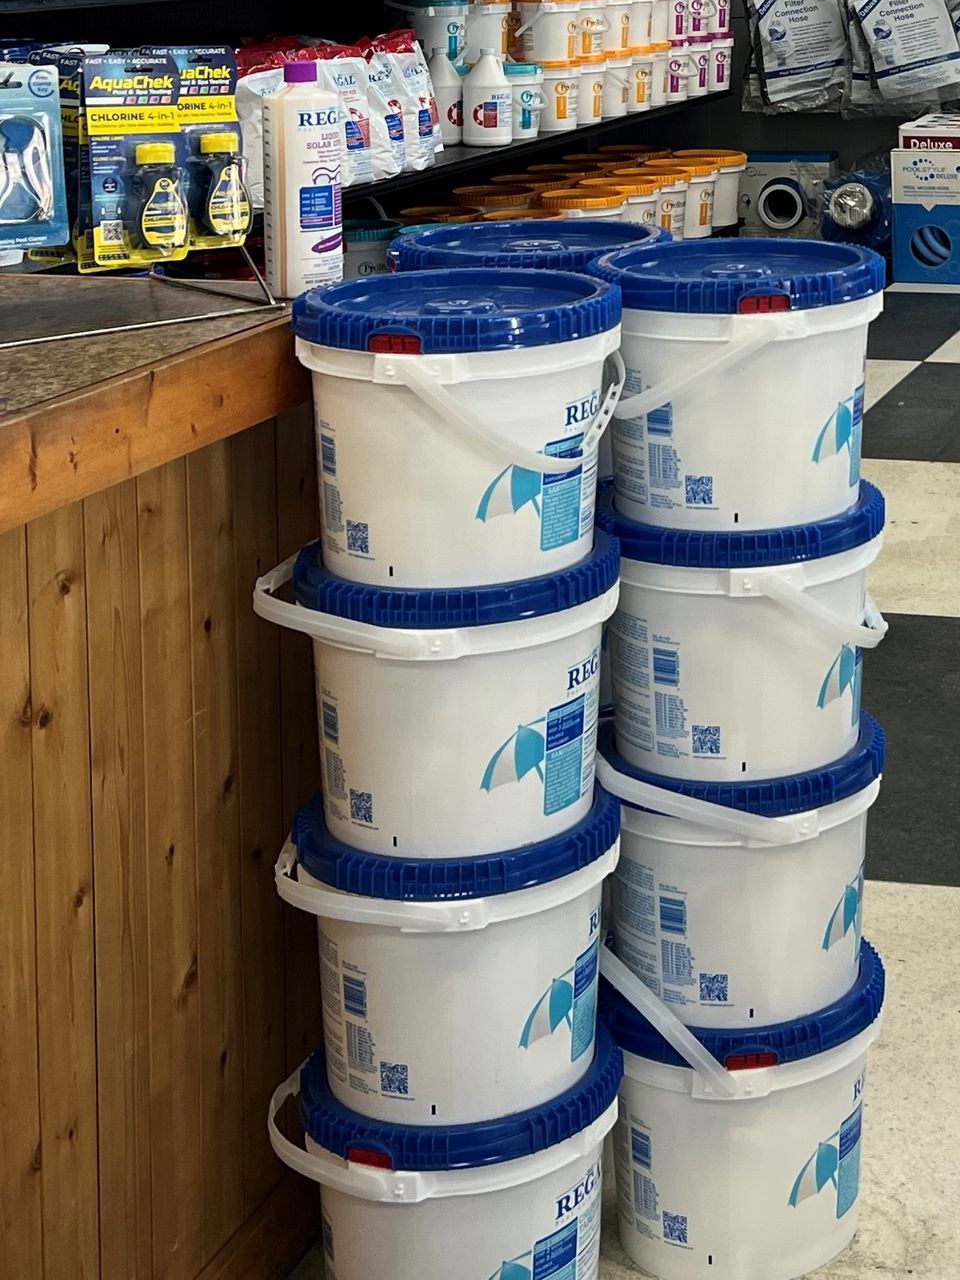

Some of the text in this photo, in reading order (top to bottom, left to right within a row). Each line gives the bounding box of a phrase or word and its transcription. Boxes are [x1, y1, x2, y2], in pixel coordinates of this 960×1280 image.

[775, 5, 819, 18] Connection
[879, 2, 924, 17] Connection
[788, 15, 809, 23] Hose
[893, 12, 915, 22] Hose
[89, 75, 174, 92] AquaChek
[91, 113, 145, 122] CHLORINE
[147, 112, 175, 120] 4-in-1
[306, 142, 331, 150] SOLAR
[910, 138, 953, 150] Deluxe
